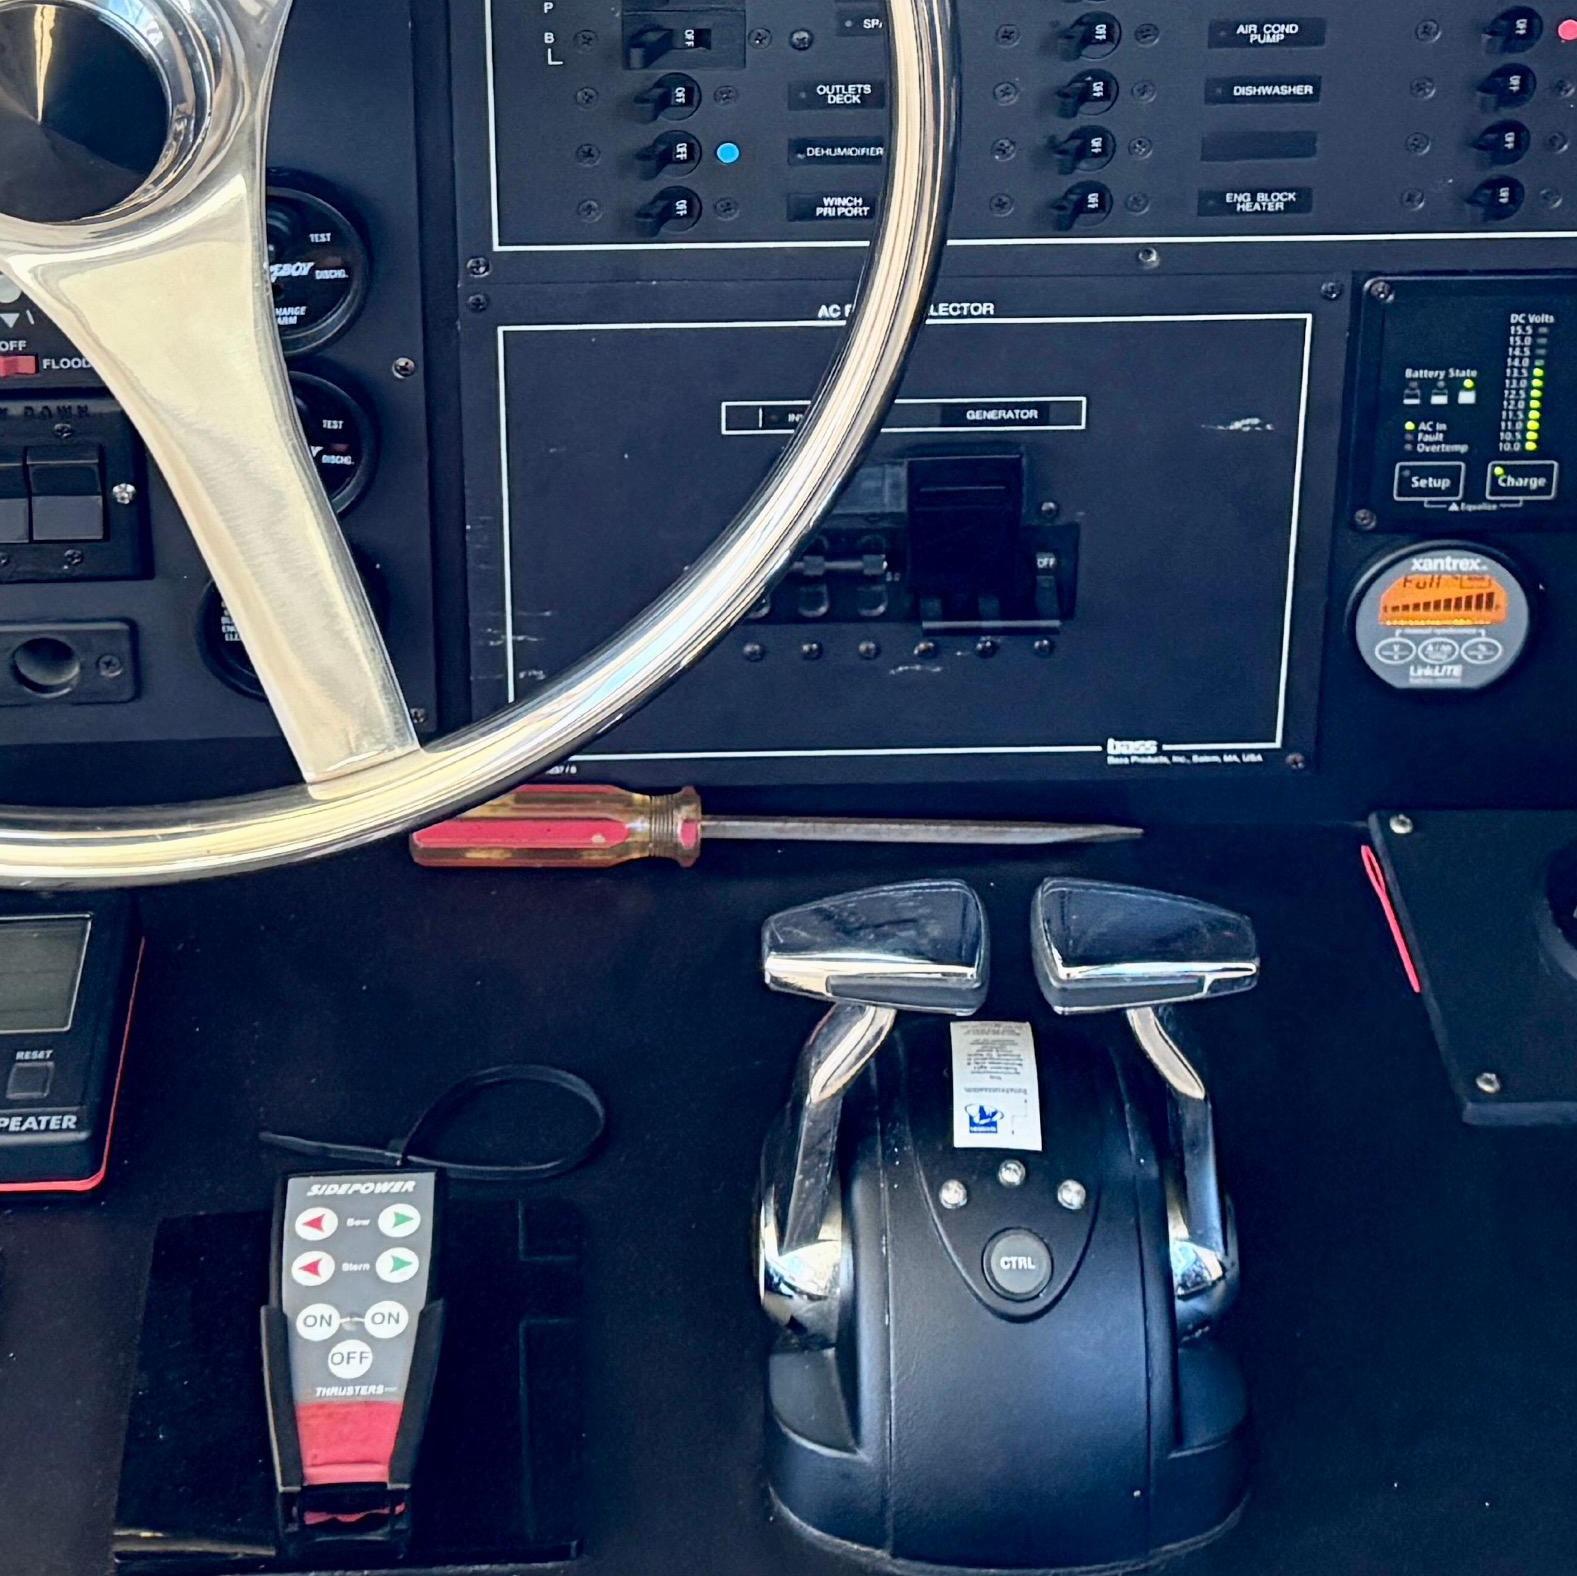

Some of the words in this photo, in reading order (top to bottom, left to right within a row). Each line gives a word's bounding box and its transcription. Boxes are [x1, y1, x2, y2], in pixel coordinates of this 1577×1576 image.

[817, 85, 871, 95] OUTLETS
[1234, 85, 1313, 95] DISHWASHER
[828, 93, 861, 103] DECK
[1511, 314, 1525, 323] DC
[1528, 314, 1554, 323] Volts
[1405, 369, 1445, 379] Battery
[1449, 368, 1477, 377] State
[967, 410, 1038, 420] GENERATOR
[1412, 476, 1450, 490] Setup
[1498, 475, 1546, 490] Charge
[16, 1050, 52, 1059] RESET
[307, 1181, 416, 1196] SIDEPOWER
[342, 1263, 370, 1271] Stern
[1000, 1257, 1036, 1269] CTRL
[304, 1314, 332, 1327] ON
[371, 1312, 400, 1325] ON
[331, 1352, 369, 1365] OFF
[315, 1385, 384, 1396] THRUSTERS
